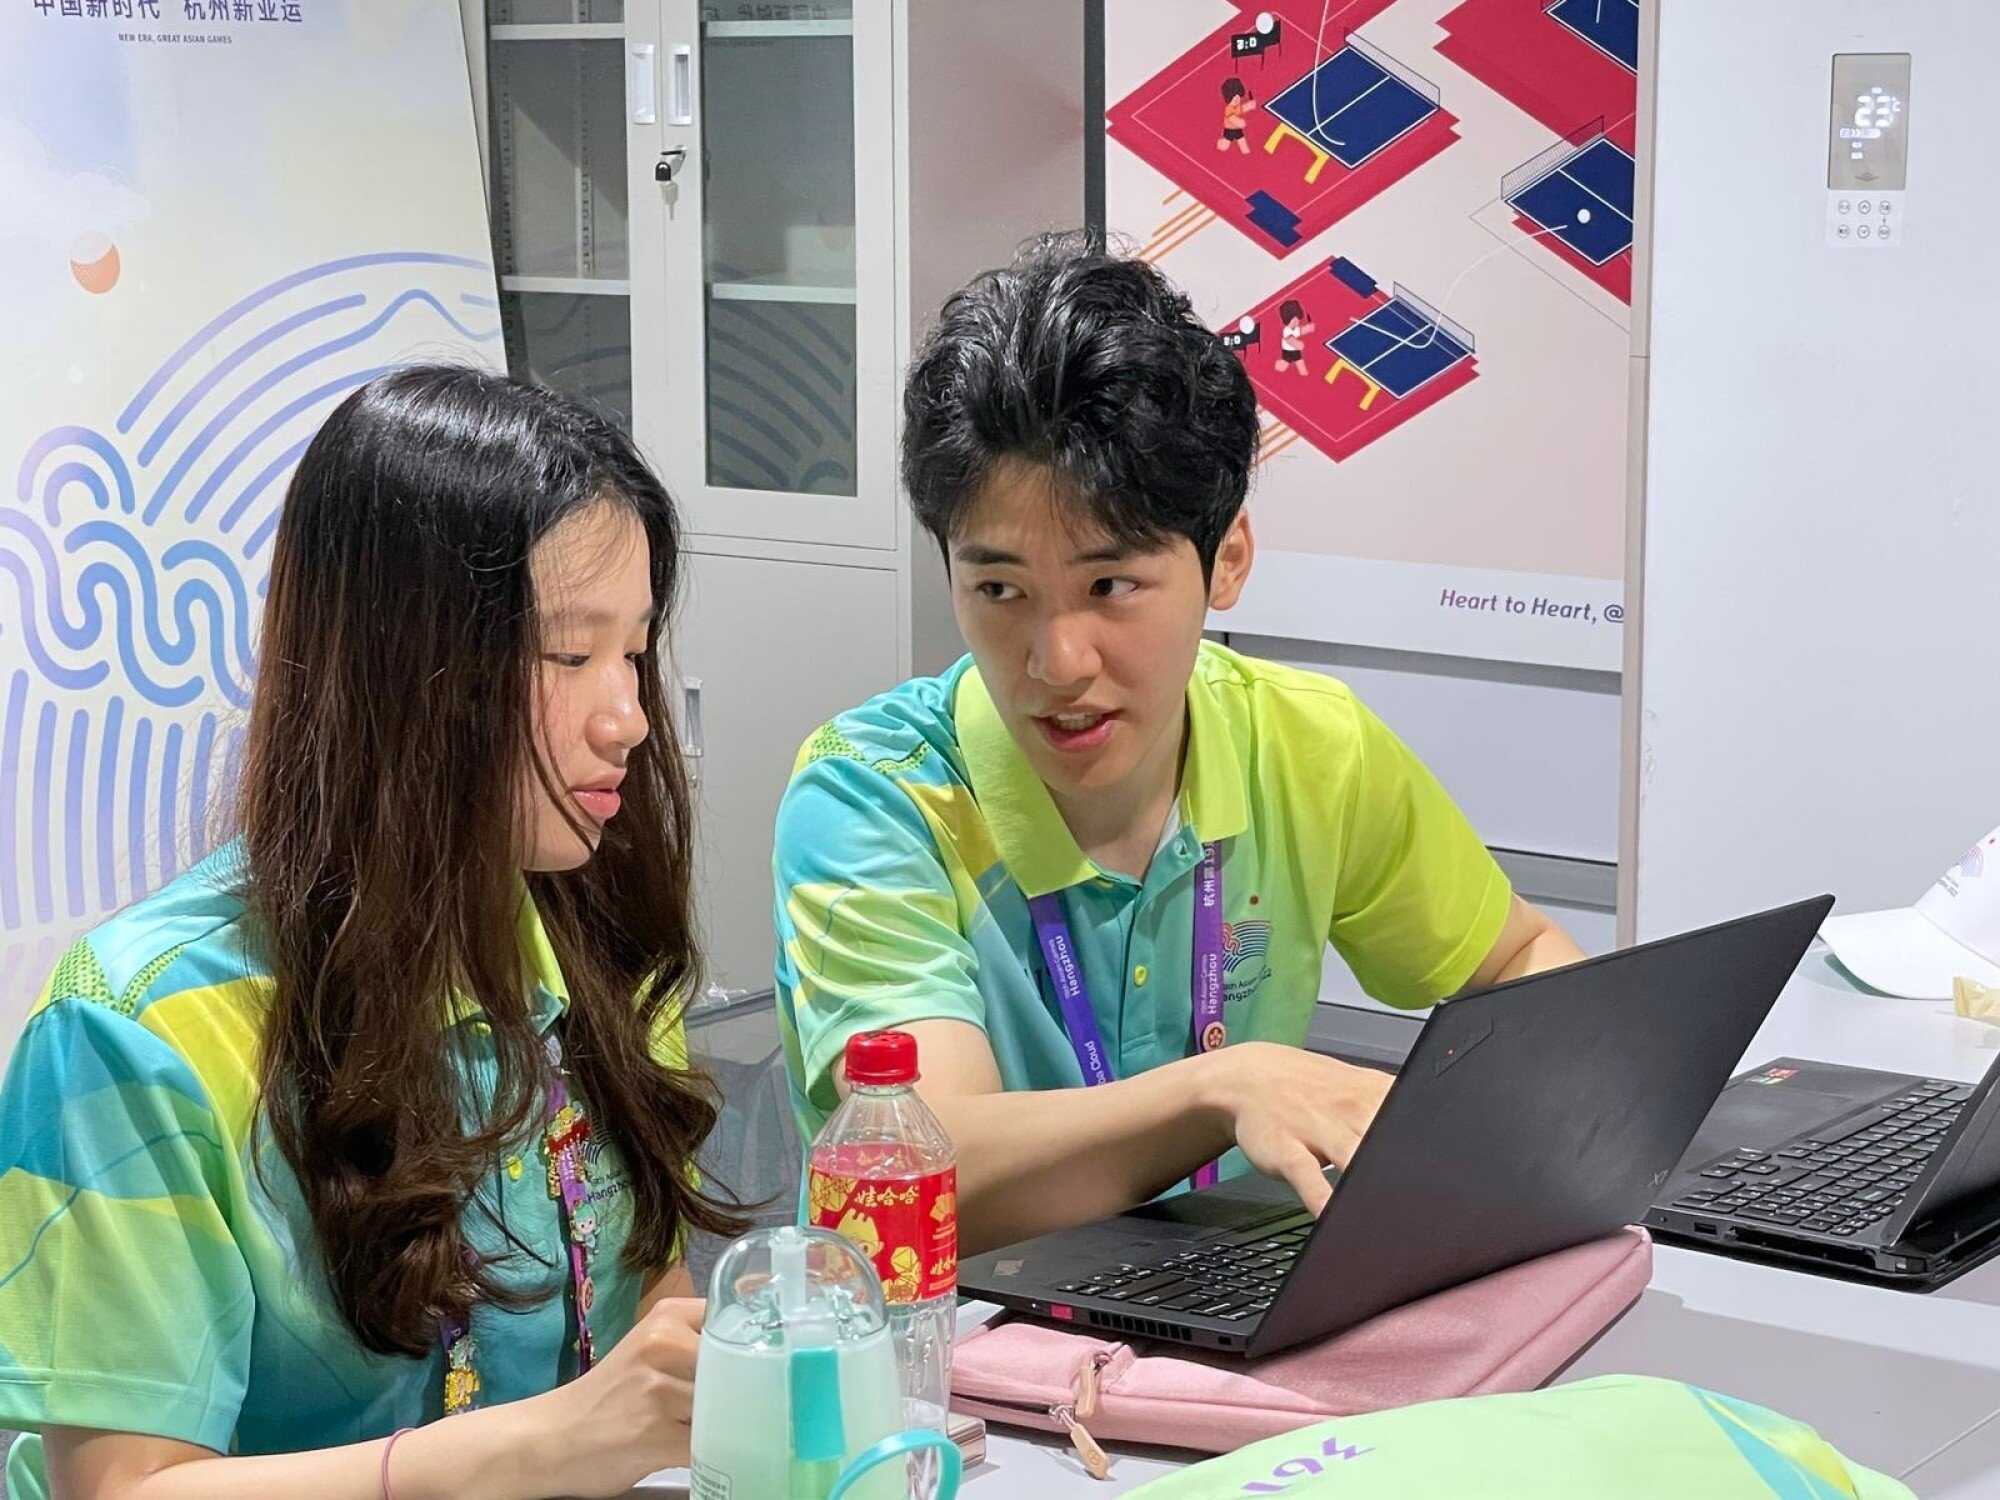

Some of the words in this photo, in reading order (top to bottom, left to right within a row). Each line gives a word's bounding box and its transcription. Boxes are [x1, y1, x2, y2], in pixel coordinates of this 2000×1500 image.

[157, 34, 181, 44] GREAT
[183, 35, 205, 44] ASIAN
[1440, 588, 1497, 612] Heart
[1504, 595, 1526, 614] to
[1530, 596, 1598, 625] Heart,
[1056, 935, 1081, 997] Hangzhou
[1207, 953, 1218, 1014] Hangzhou
[1084, 1040, 1101, 1072] Cloud
[854, 1185, 919, 1208] 娃哈哈
